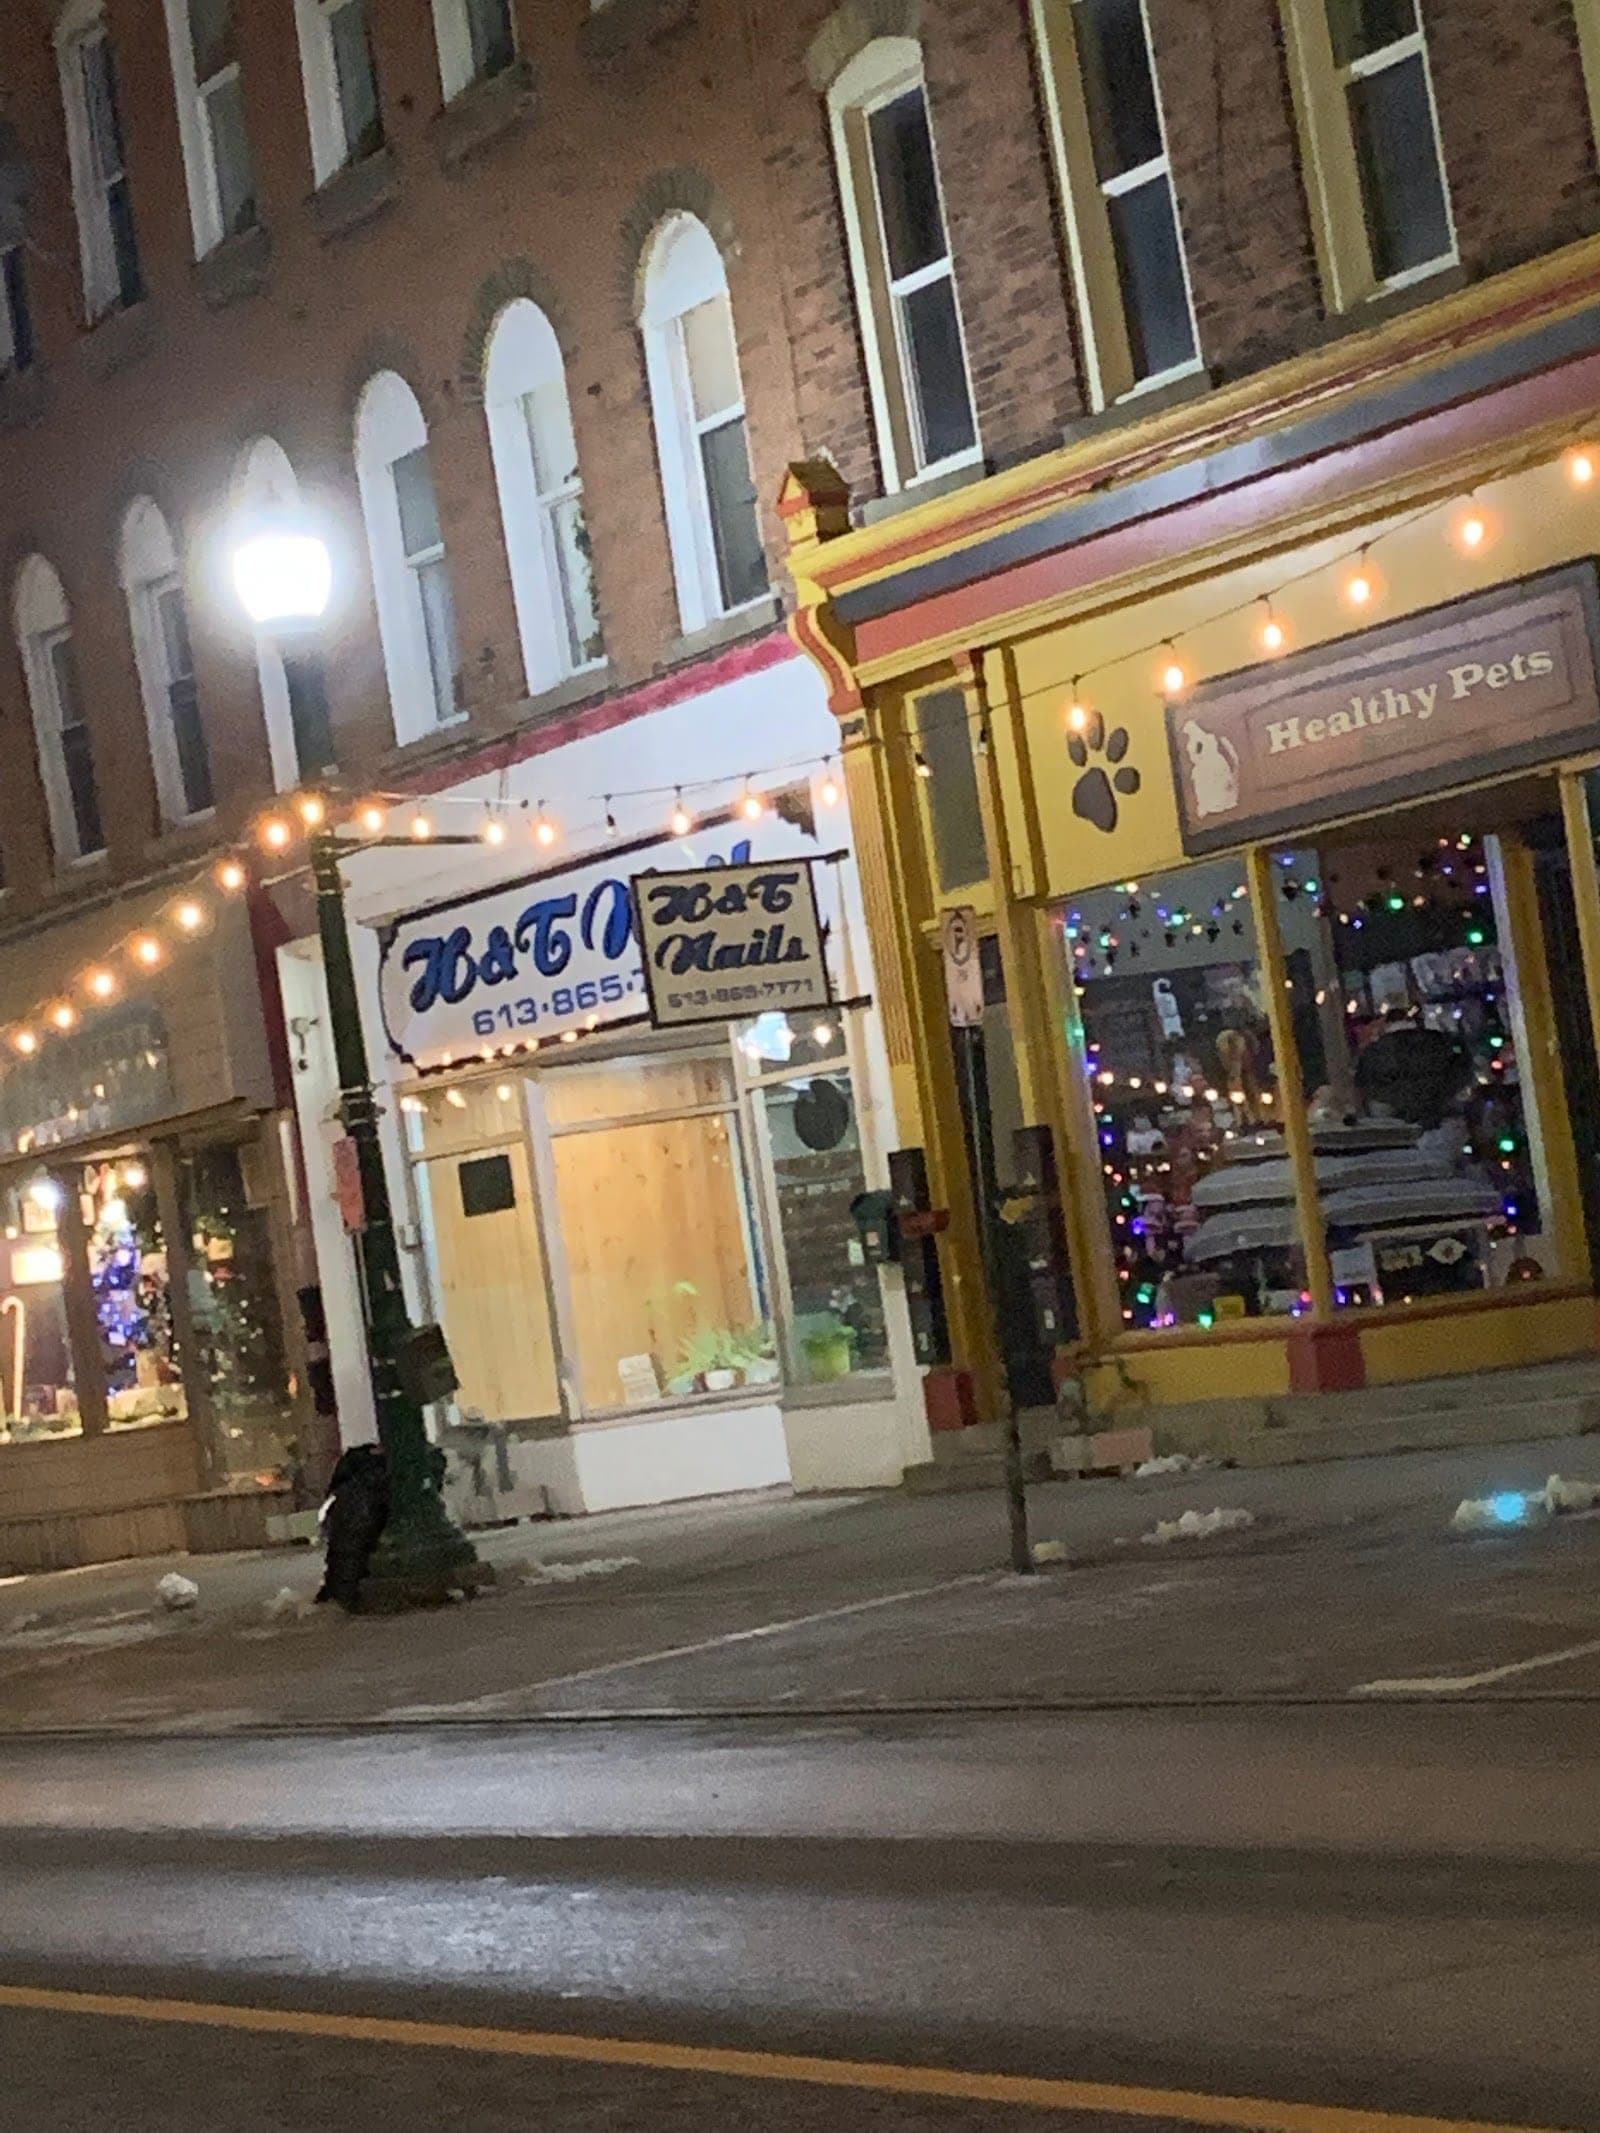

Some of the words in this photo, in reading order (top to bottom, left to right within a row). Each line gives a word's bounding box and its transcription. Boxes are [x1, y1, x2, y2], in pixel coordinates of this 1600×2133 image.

[1265, 683, 1437, 753] Healthy
[1448, 651, 1553, 699] Pets
[648, 872, 799, 926] H&T
[403, 893, 577, 1012] H&T
[655, 924, 810, 975] Nails
